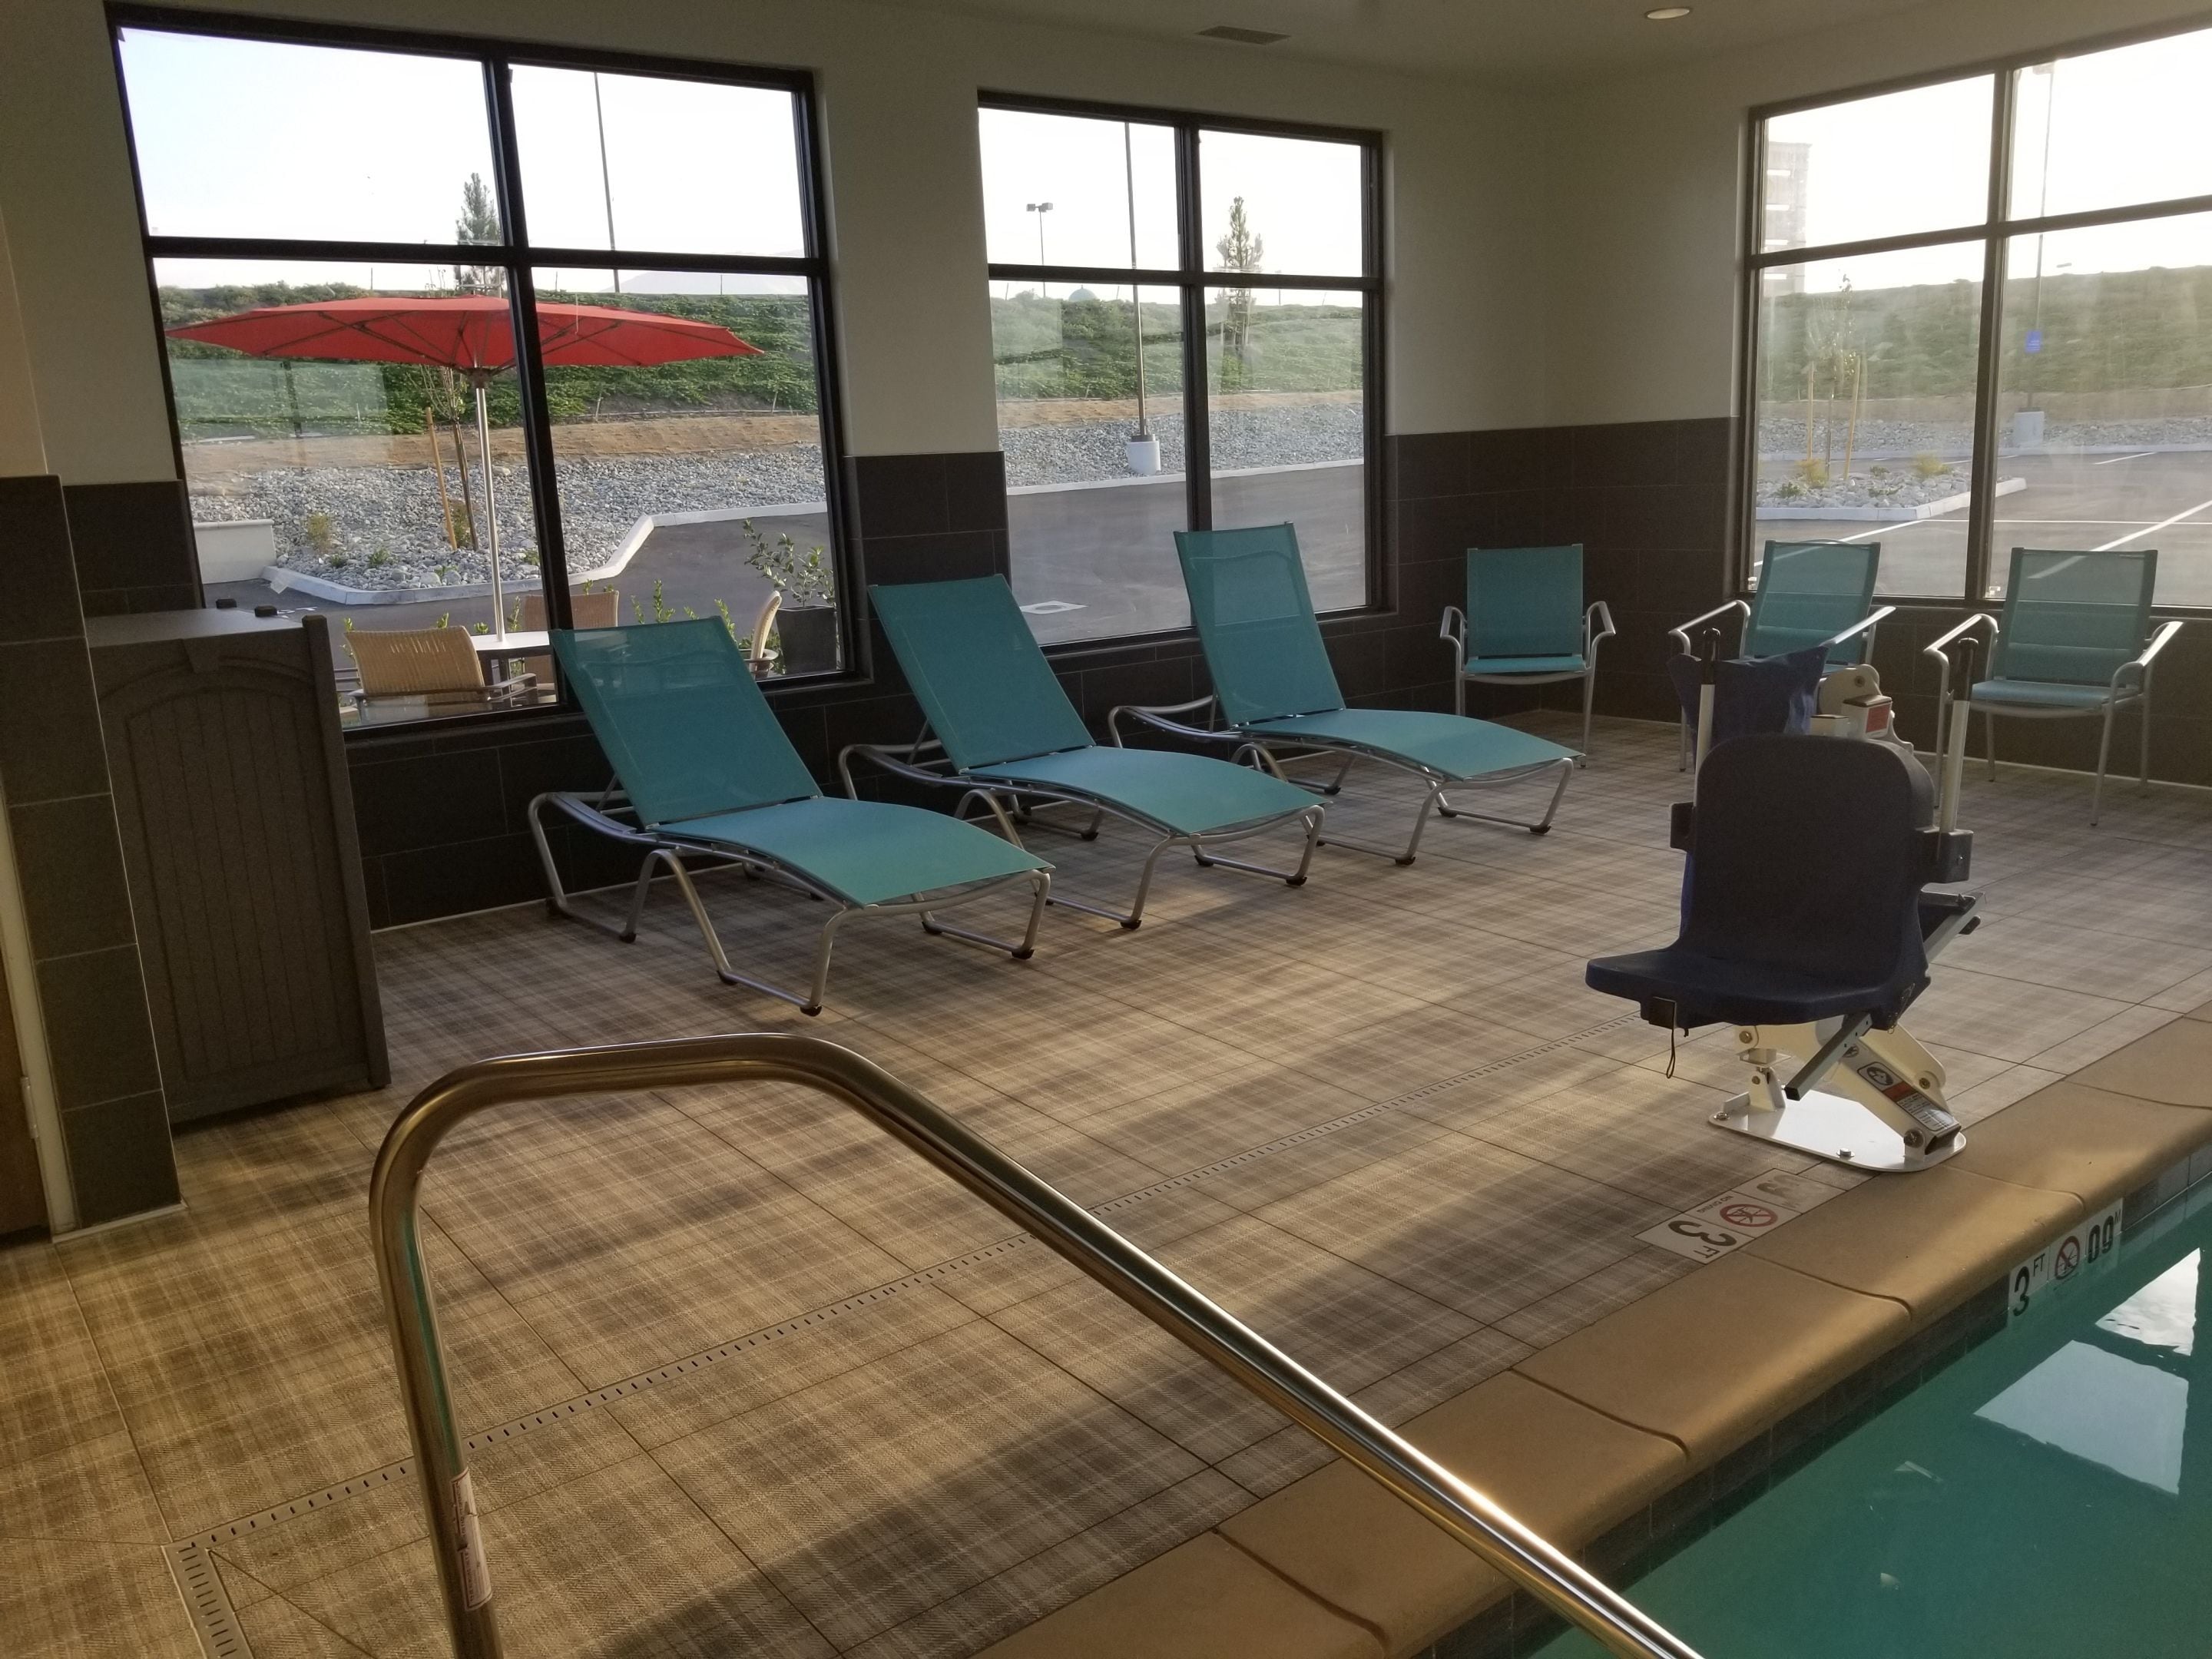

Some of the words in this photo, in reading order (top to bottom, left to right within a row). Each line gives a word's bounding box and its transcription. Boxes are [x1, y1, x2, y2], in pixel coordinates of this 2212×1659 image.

[1696, 1200, 1723, 1213] DIVING
[1667, 1220, 1737, 1247] 3
[1693, 1244, 1721, 1259] FT
[2013, 1266, 2030, 1316] 3
[2033, 1253, 2045, 1277] FT
